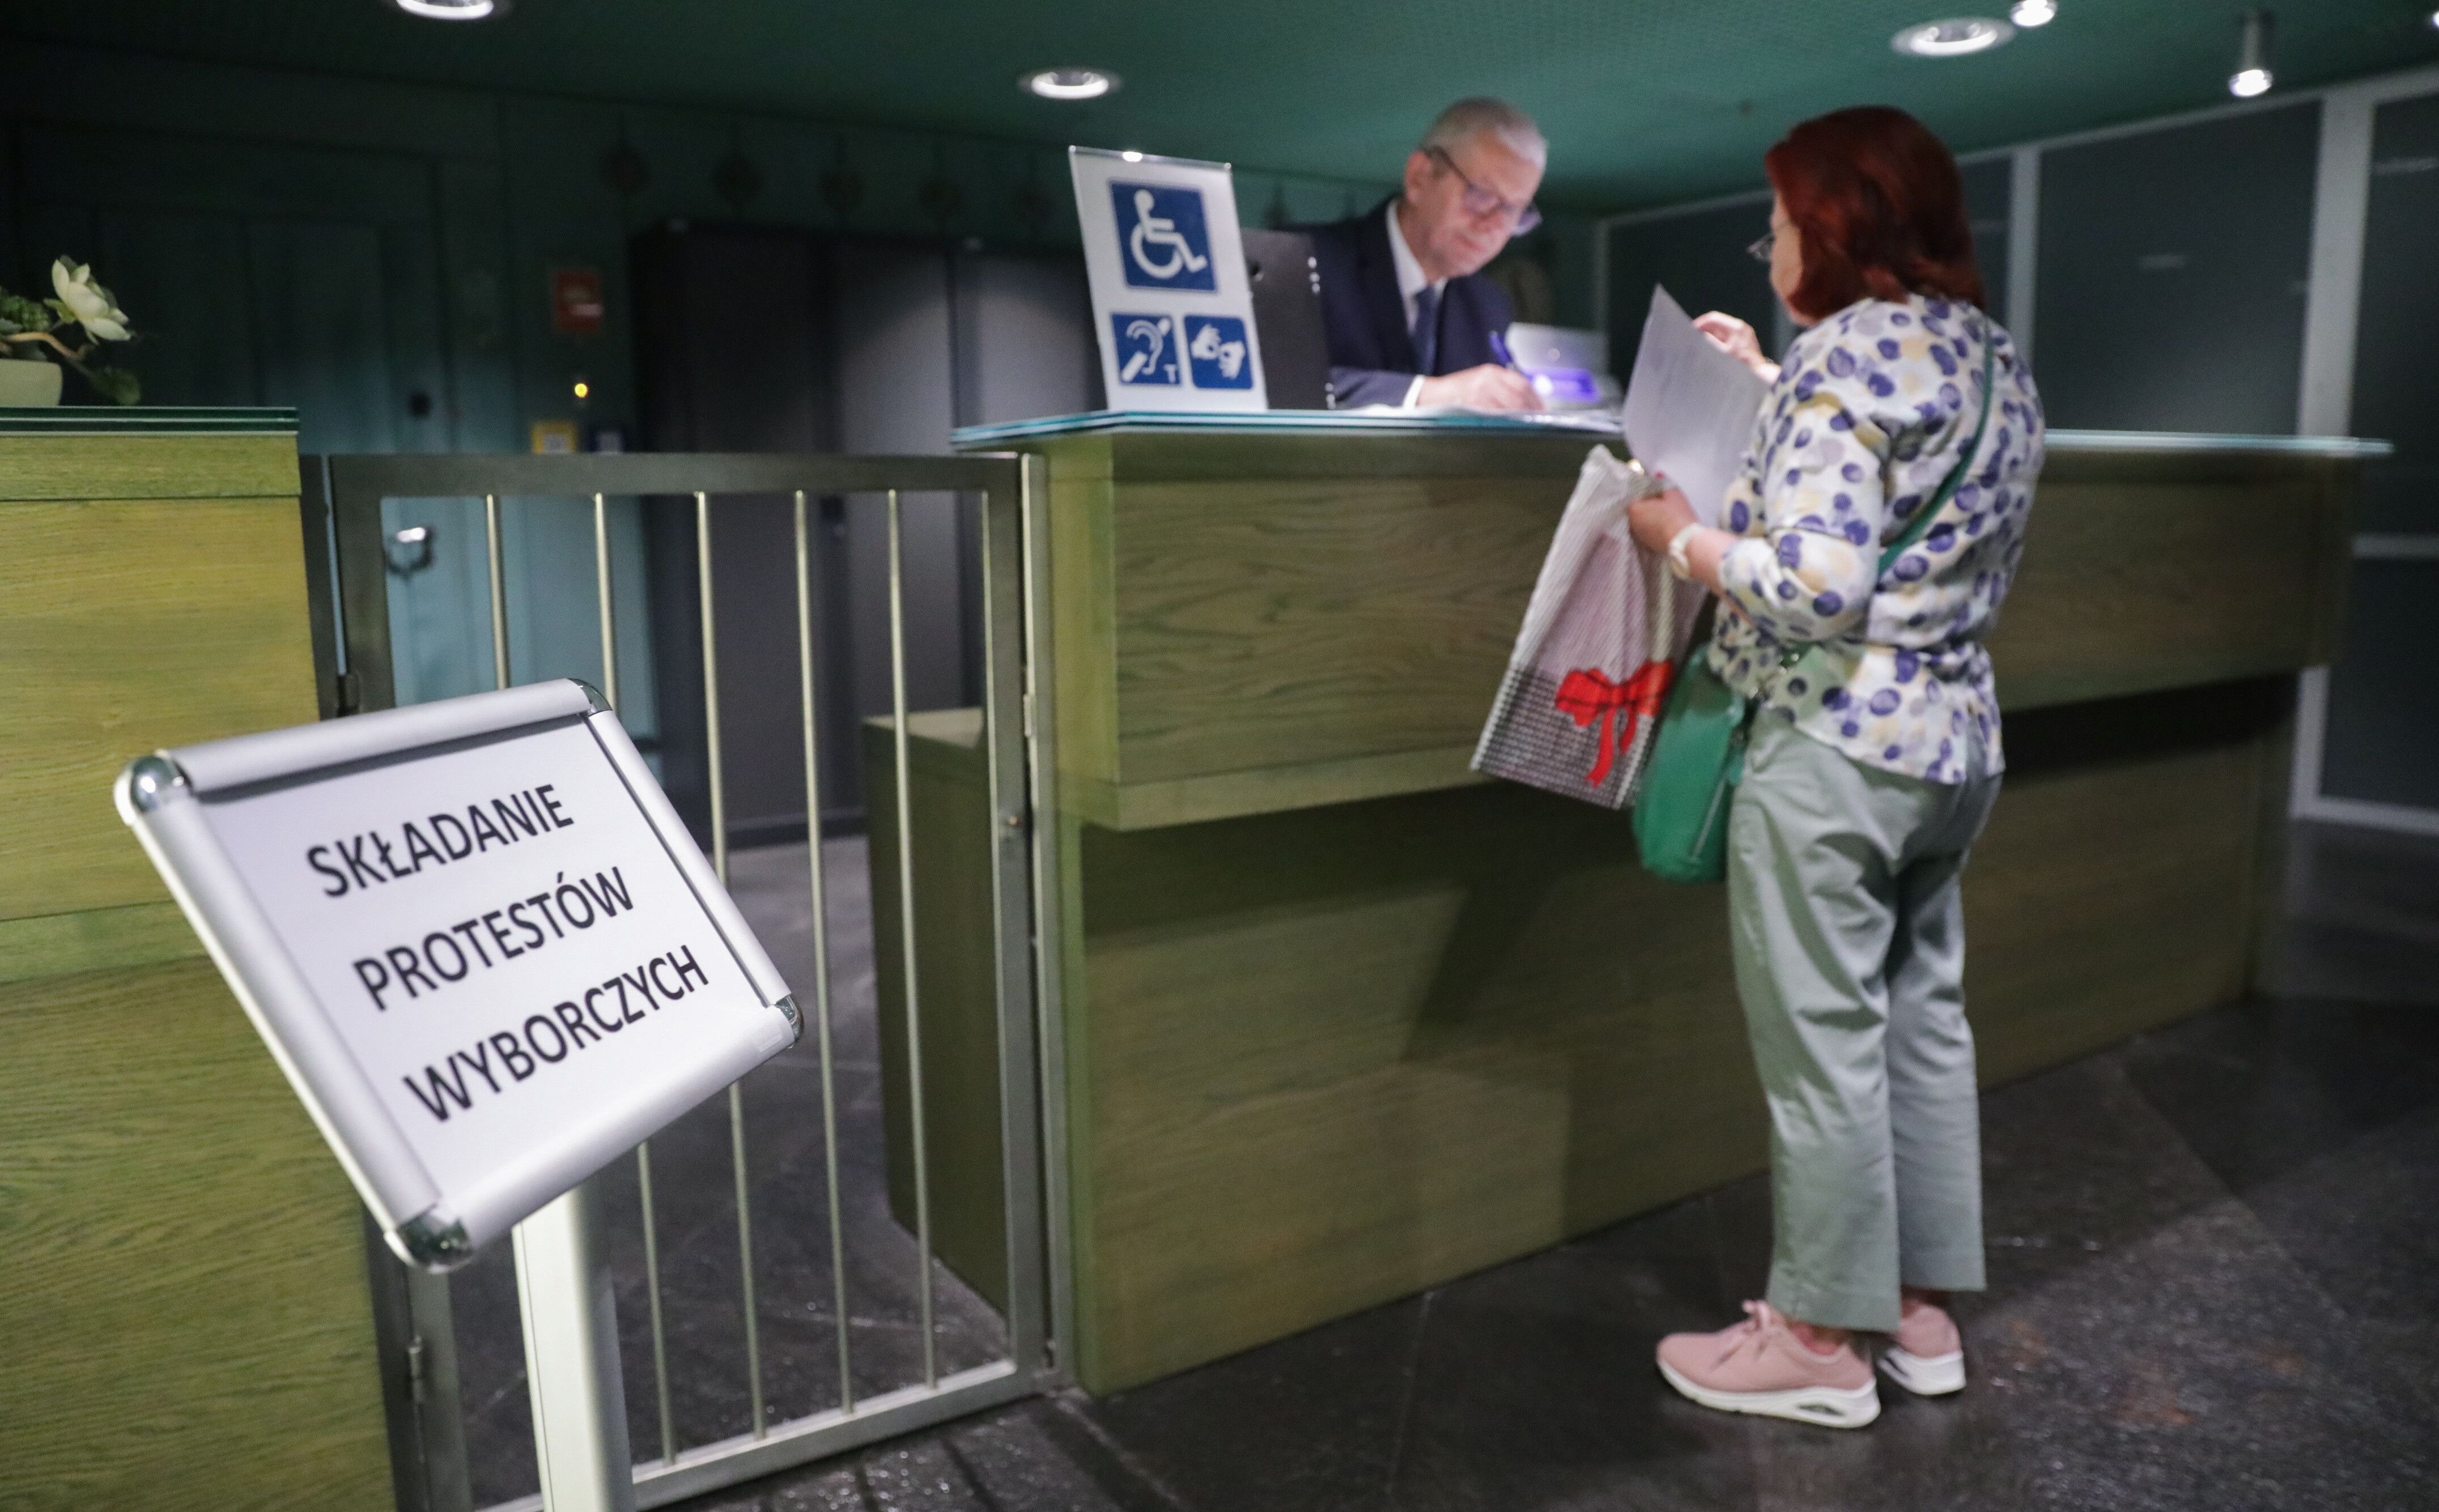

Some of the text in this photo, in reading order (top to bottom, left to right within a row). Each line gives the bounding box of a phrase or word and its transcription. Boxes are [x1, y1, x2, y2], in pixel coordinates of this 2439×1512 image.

[307, 784, 574, 897] SKŁADANIE
[353, 866, 634, 1011] PROTESTÓW
[403, 945, 709, 1122] WYBORCZYCH
